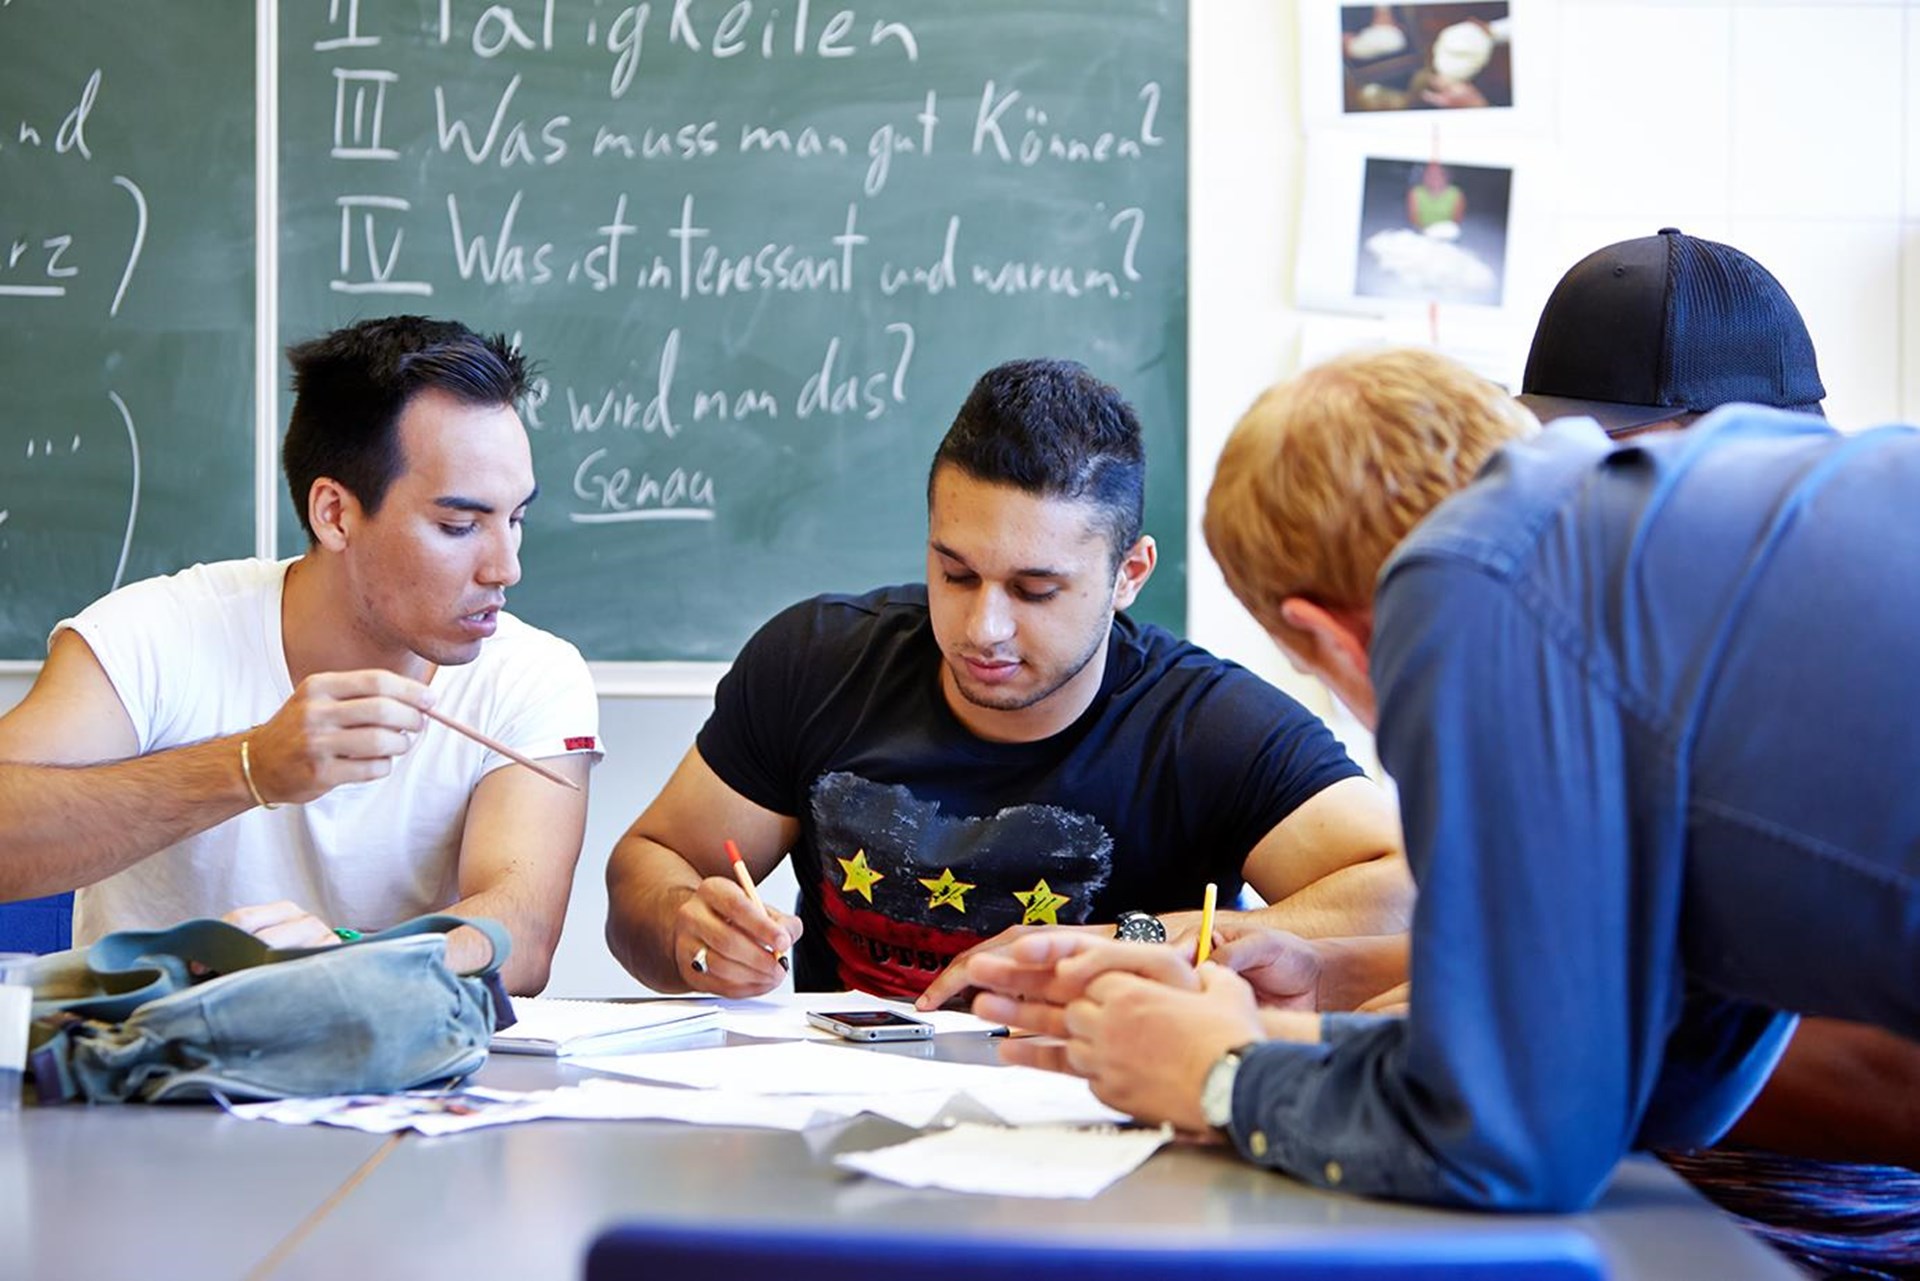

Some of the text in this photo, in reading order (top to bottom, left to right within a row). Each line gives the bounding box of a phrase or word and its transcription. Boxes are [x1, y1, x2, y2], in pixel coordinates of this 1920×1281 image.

[330, 66, 400, 161] III
[434, 72, 572, 168] Was
[592, 121, 720, 161] muss
[739, 123, 849, 158] man
[863, 88, 939, 198] gut
[329, 189, 1145, 300] IV Was ist interessant und warum?
[566, 327, 682, 439] wird
[692, 387, 779, 422] man
[796, 321, 916, 421] das?
[573, 447, 716, 512] Genau
